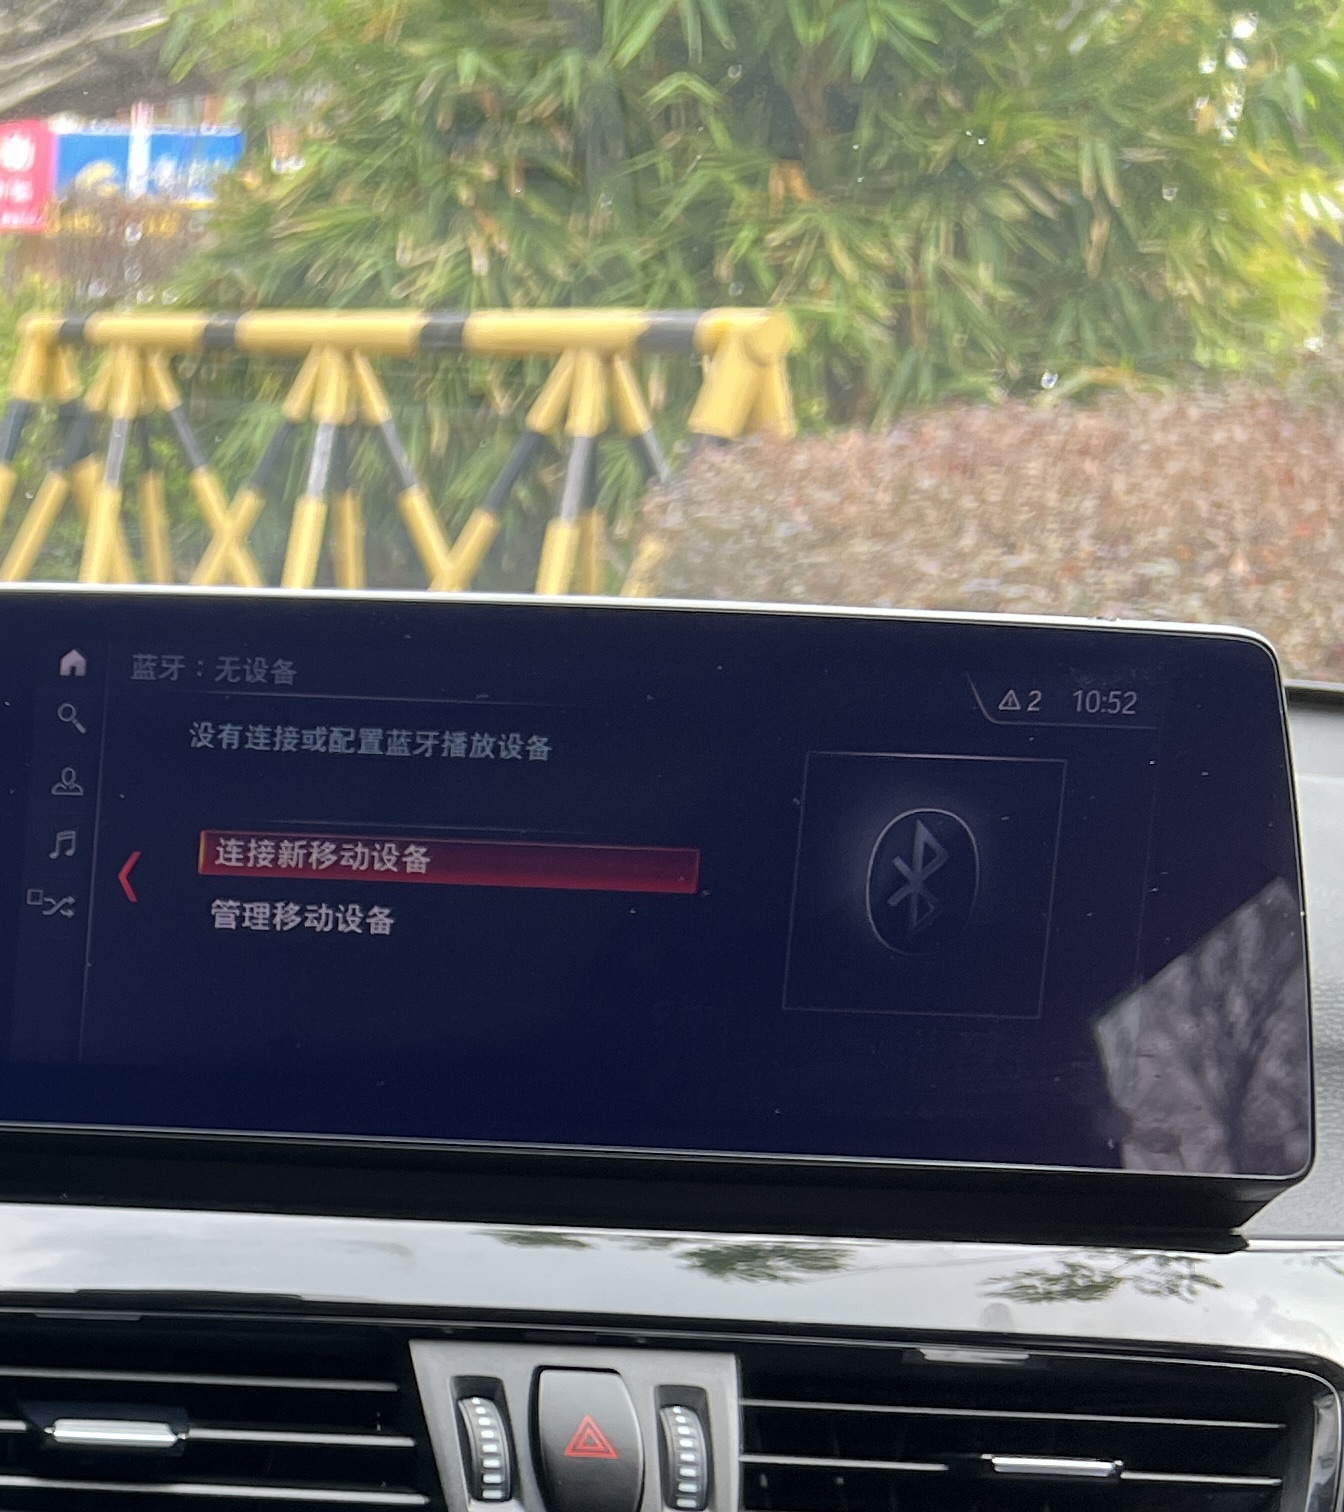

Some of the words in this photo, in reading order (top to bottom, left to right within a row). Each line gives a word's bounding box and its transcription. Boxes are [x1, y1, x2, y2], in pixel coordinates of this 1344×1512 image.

[1026, 690, 1042, 712] 2
[1072, 689, 1138, 715] 10:52
[188, 721, 553, 762] 没有连接或配置蓝牙播放设备
[214, 837, 431, 874] 连接新移动设备
[210, 899, 395, 936] 管理移动设备
